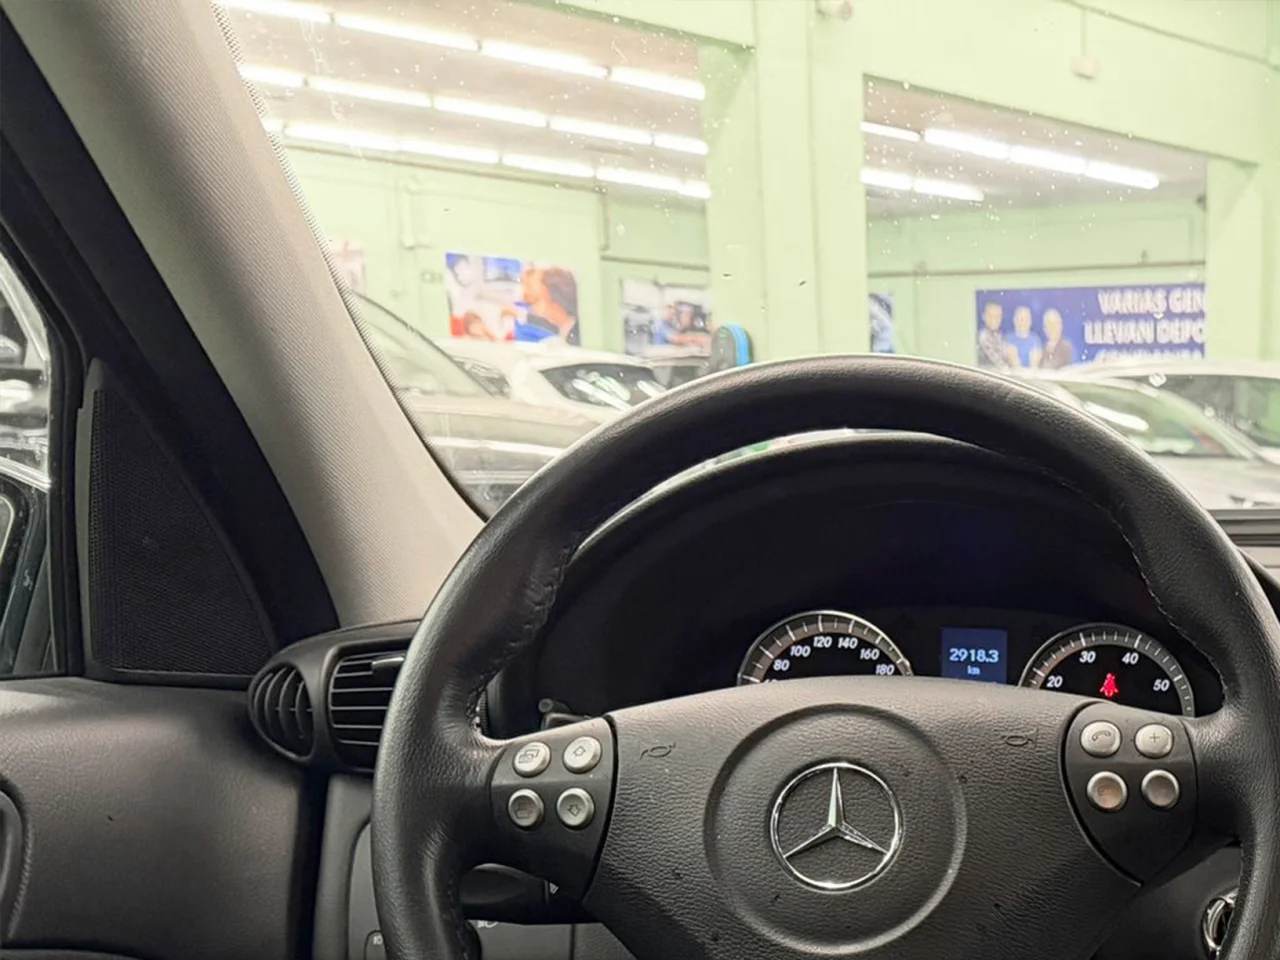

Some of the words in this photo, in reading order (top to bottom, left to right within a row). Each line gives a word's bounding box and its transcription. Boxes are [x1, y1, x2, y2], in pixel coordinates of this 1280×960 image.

[813, 636, 832, 648] 120
[838, 637, 858, 649] 140
[790, 646, 811, 657] 100
[859, 649, 880, 660] 160
[949, 648, 1000, 664] 2918.3
[1079, 651, 1096, 663] 30
[1122, 652, 1139, 665] 40
[773, 659, 790, 671] 80
[875, 664, 895, 676] 180
[967, 665, 981, 676] km
[1046, 676, 1063, 689] 20
[1153, 679, 1170, 692] 50
